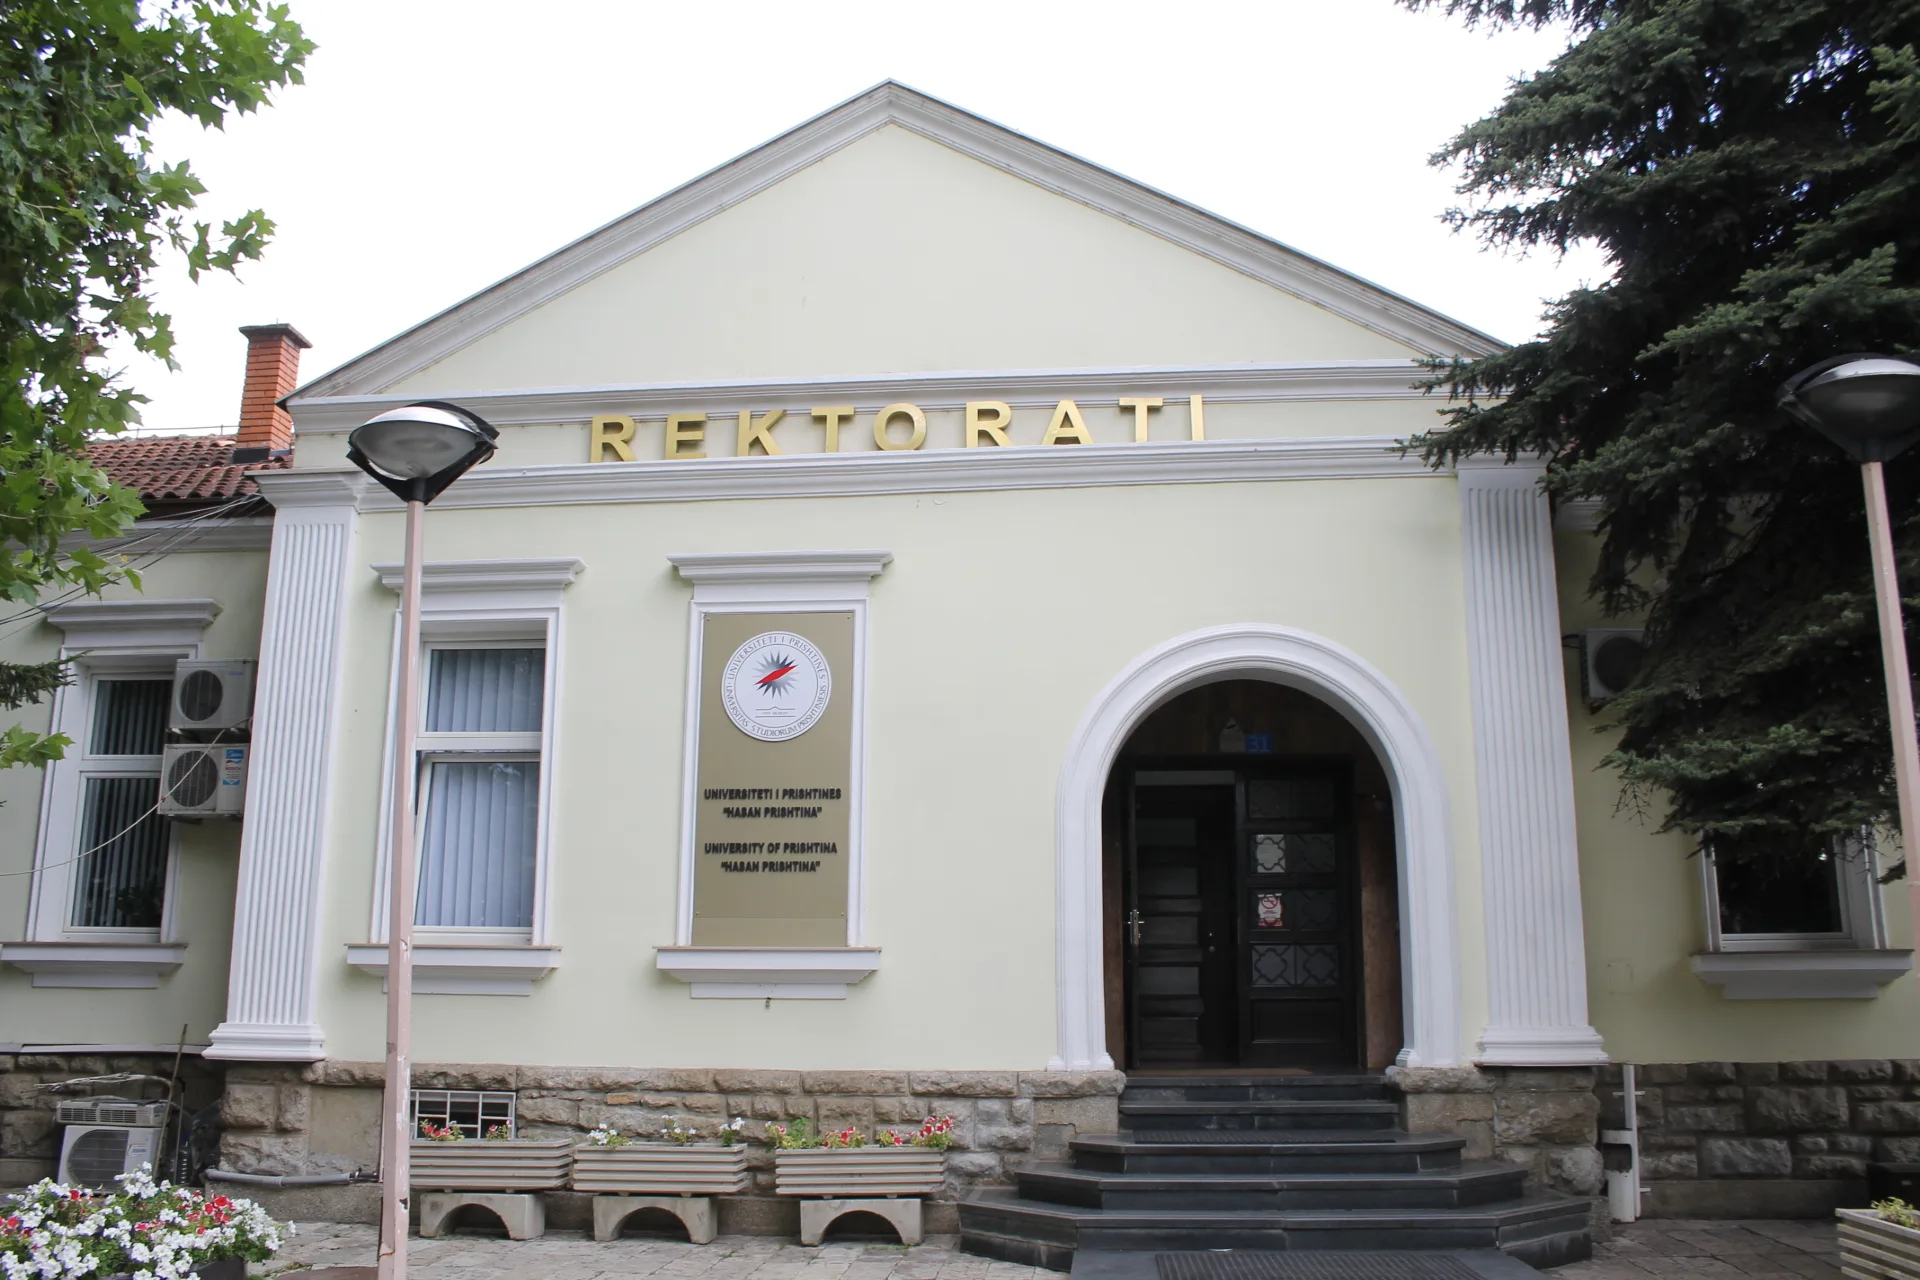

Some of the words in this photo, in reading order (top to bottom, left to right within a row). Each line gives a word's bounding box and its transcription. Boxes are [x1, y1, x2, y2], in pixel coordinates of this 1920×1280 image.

[590, 394, 1205, 463] REKTORATI
[728, 636, 776, 679] UNIVERSITETI
[752, 725, 798, 737] STUDIORUM
[704, 788, 772, 800] UNIVERSITETI
[704, 842, 765, 854] UNIVERSITY
[767, 842, 781, 854] OF
[783, 842, 837, 854] PRISHTINA
